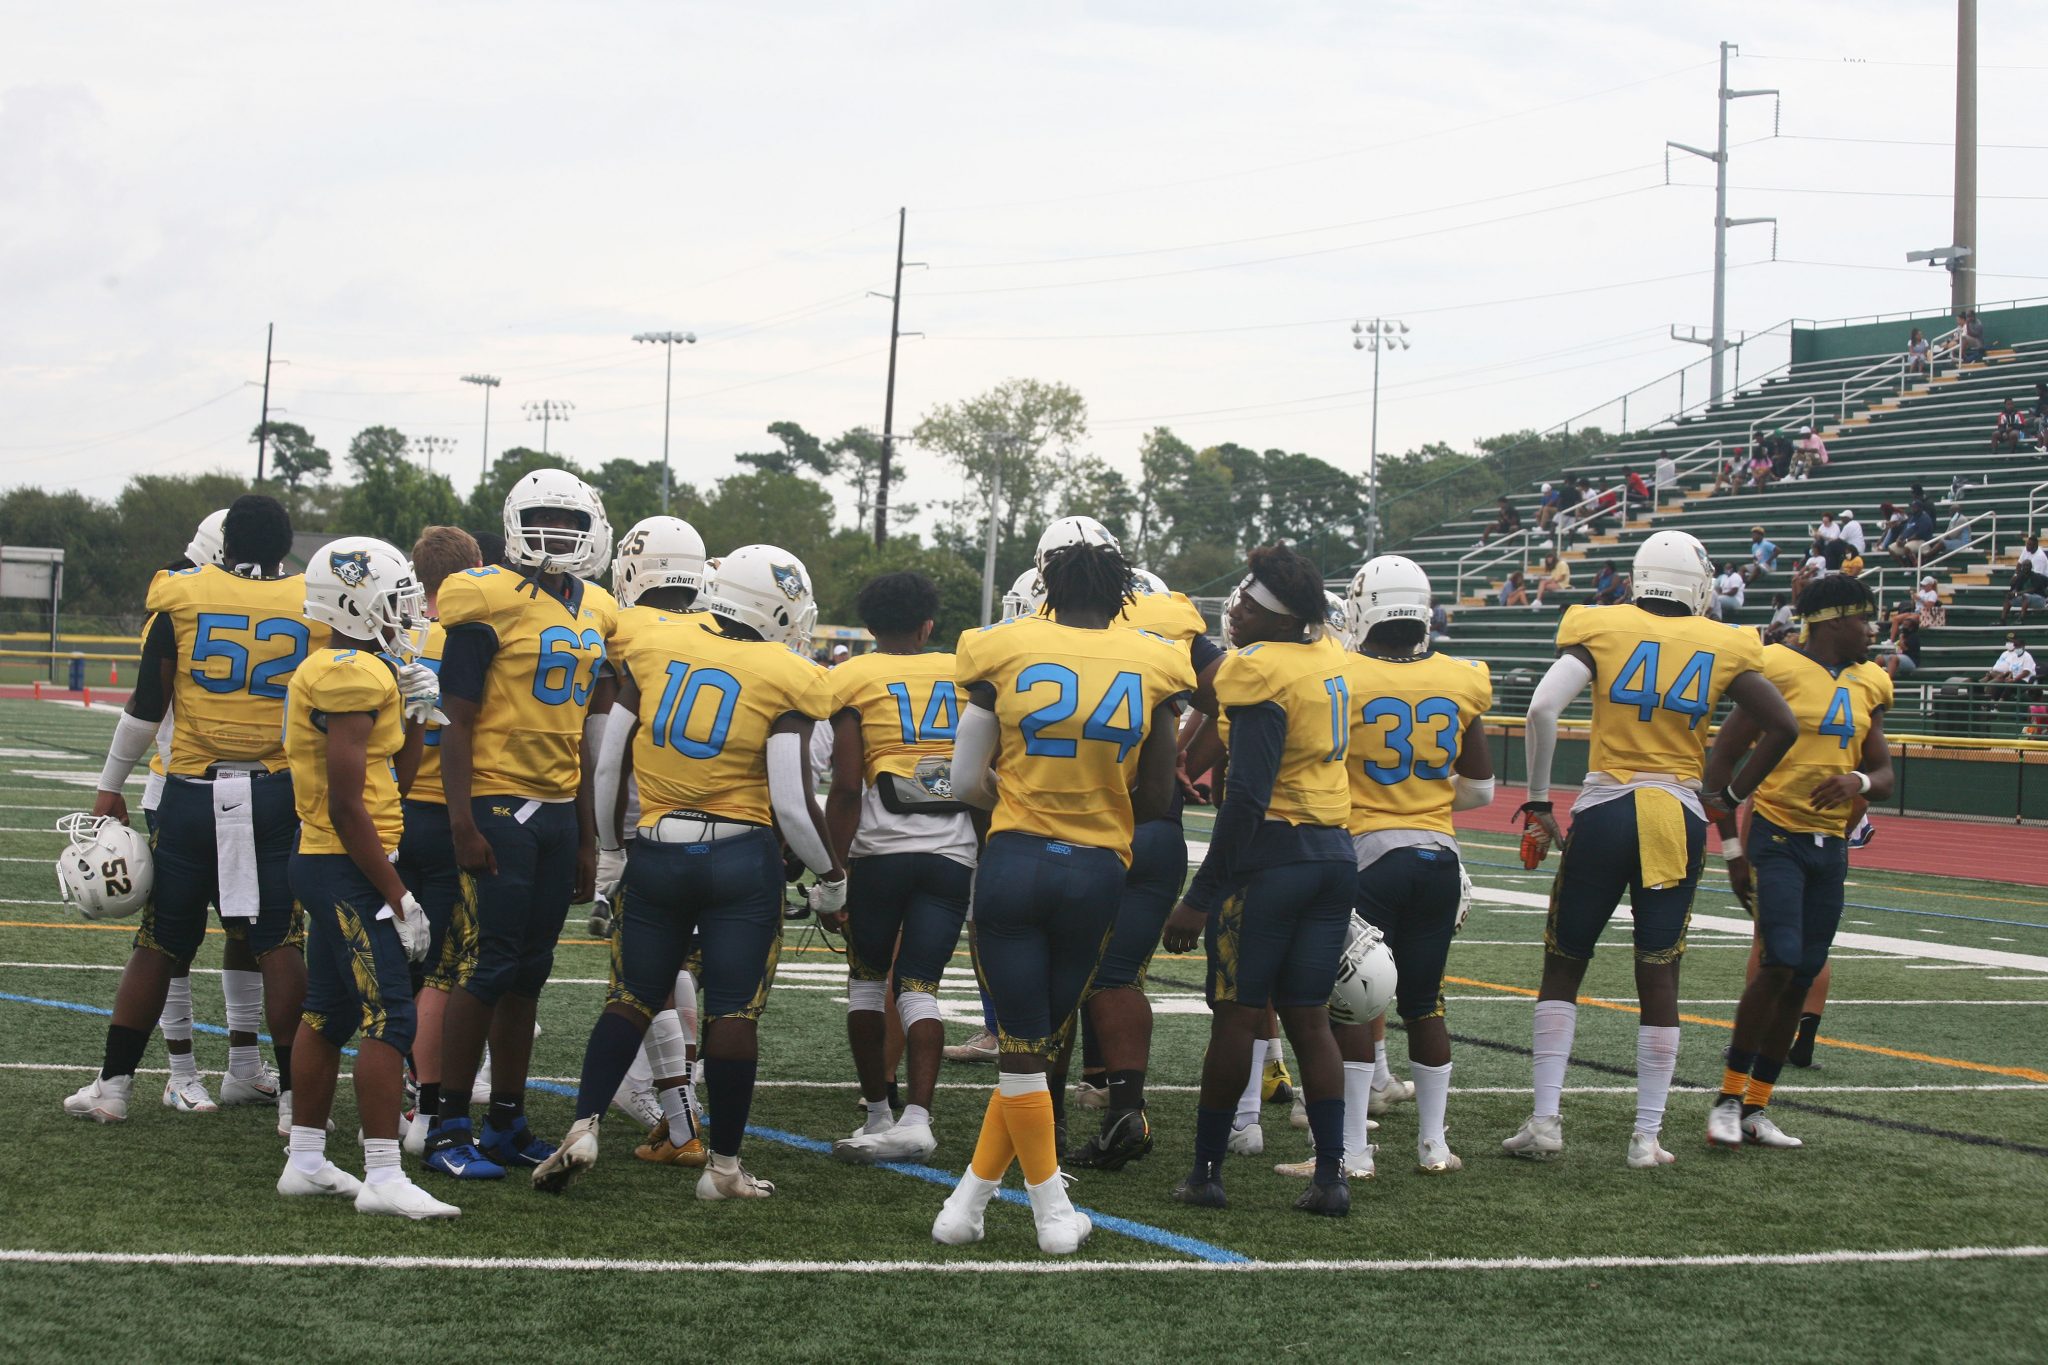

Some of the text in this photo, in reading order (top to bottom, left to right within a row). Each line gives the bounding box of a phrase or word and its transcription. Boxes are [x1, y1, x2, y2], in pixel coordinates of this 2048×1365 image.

[622, 530, 650, 556] 25
[665, 575, 694, 585] schutt
[711, 603, 736, 616] schutt
[1645, 588, 1673, 597] schutt
[1387, 608, 1417, 617] schutt
[190, 613, 310, 698] 52
[532, 625, 608, 706] 63
[1609, 640, 1715, 730] 44
[653, 659, 742, 759] 10
[886, 681, 959, 744] 14
[1016, 662, 1144, 763] 24
[1323, 675, 1349, 762] 11
[1362, 696, 1460, 785] 33
[1818, 687, 1855, 749] 4
[101, 858, 132, 897] 52
